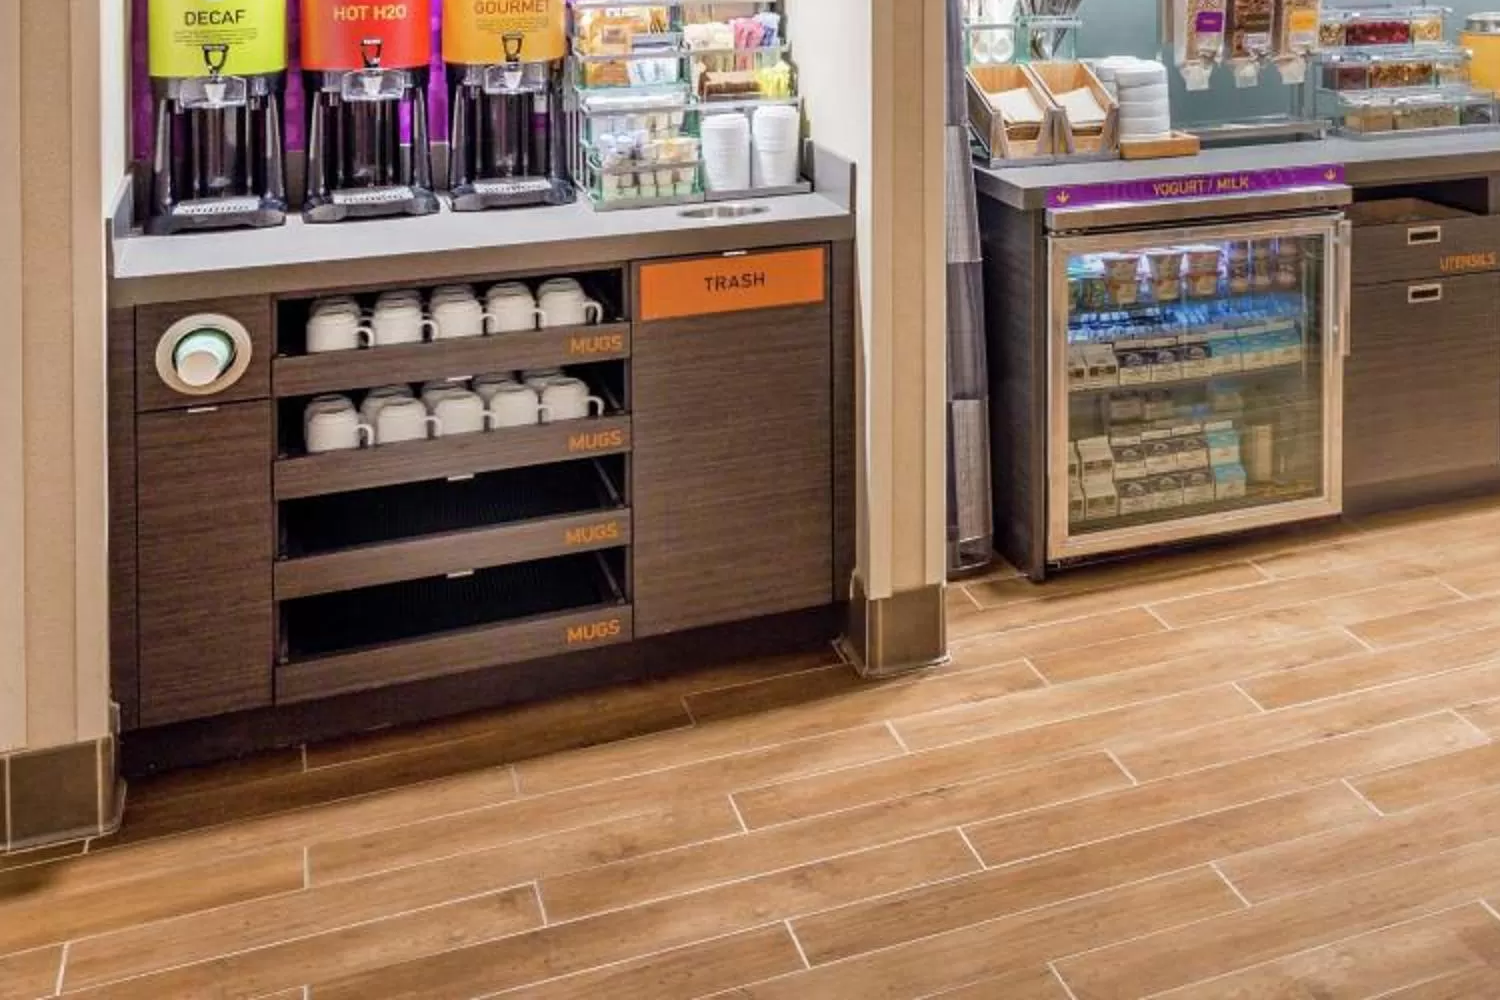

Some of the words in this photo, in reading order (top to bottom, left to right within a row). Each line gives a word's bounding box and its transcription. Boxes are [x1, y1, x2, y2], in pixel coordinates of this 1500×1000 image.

[184, 9, 247, 26] DECAF
[333, 5, 370, 21] HOT
[1152, 179, 1205, 196] YOGURT
[1216, 175, 1249, 191] MILK
[1439, 251, 1497, 271] UTENSILS
[704, 271, 766, 292] TRASH
[570, 335, 623, 354] MUGS
[568, 428, 624, 452] MUGS
[566, 521, 619, 544] MUGS
[567, 619, 621, 645] MUGS
